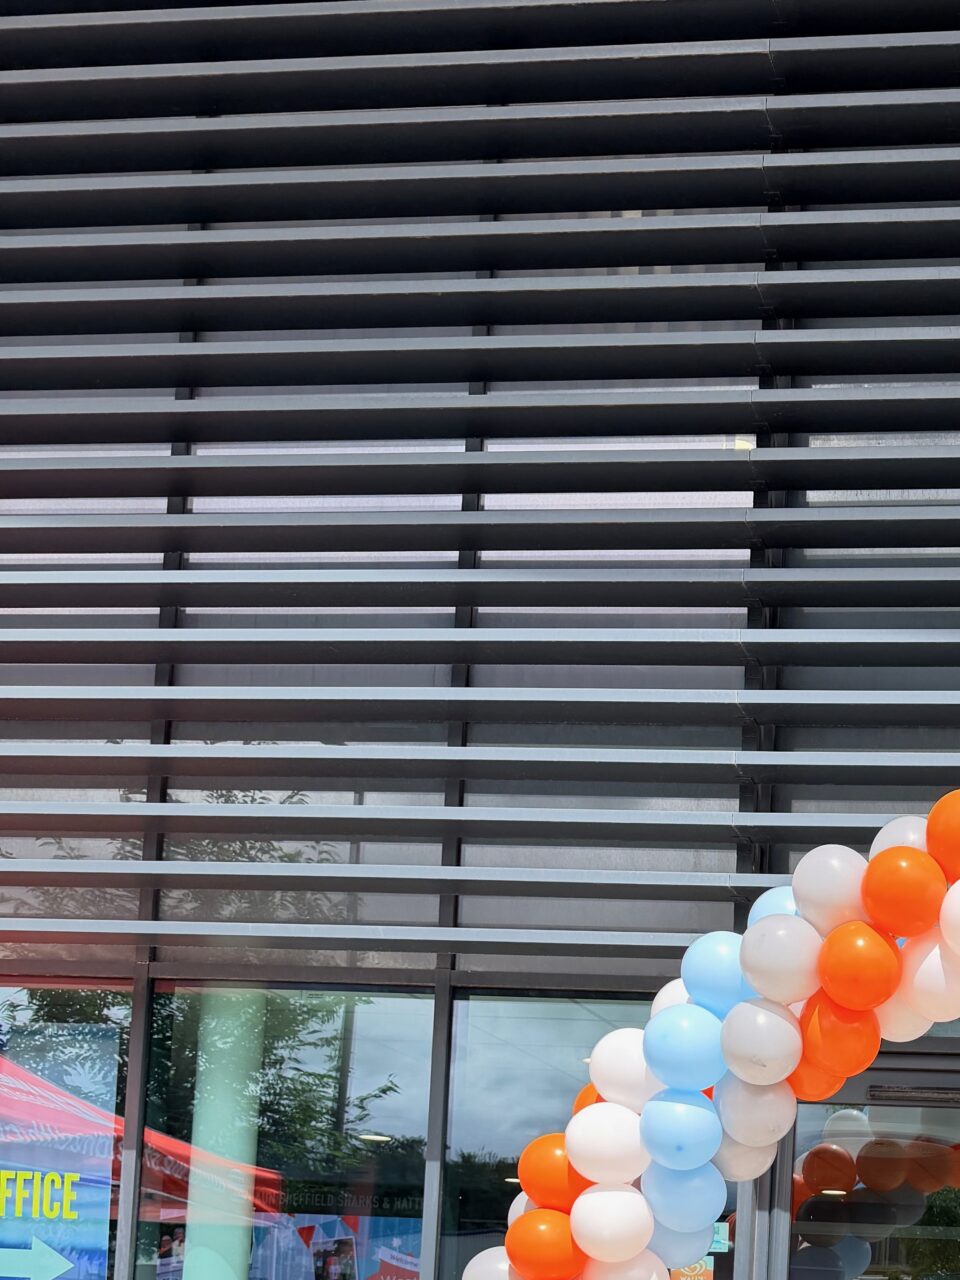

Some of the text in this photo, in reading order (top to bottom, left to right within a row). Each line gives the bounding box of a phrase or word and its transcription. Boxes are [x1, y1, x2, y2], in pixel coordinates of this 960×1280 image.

[279, 1193, 334, 1208] SHEFFIELD
[338, 1194, 379, 1208] SHARKS
[383, 1198, 390, 1209] &
